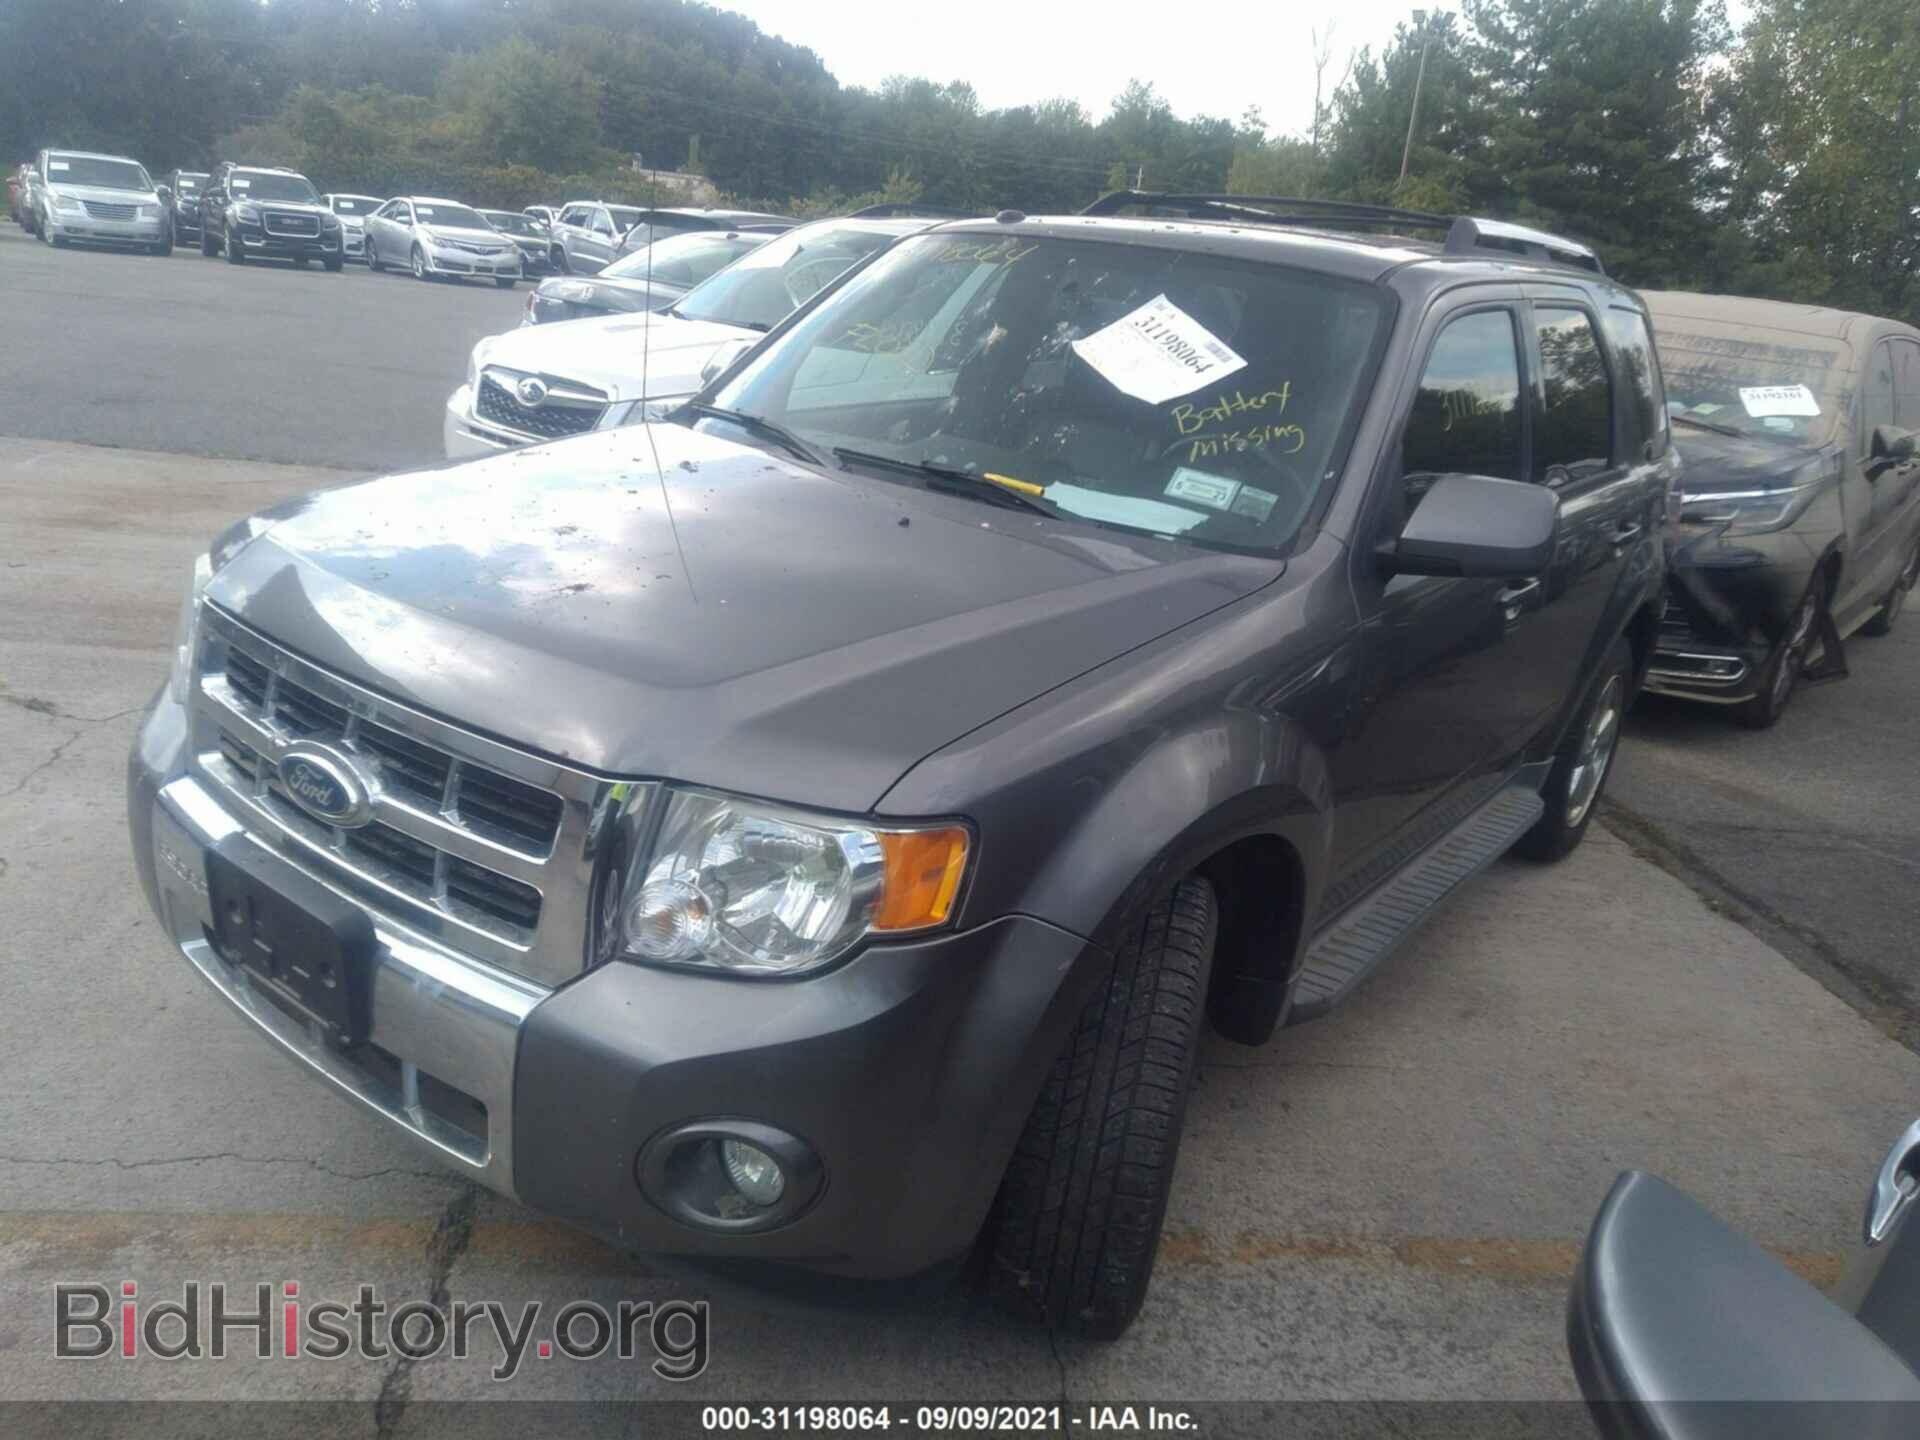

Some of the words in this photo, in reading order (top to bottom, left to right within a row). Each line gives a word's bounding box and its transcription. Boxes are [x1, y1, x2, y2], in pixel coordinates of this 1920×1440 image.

[1134, 315, 1215, 374] 31198064
[1171, 381, 1291, 435] Battery
[289, 763, 335, 807] Ford
